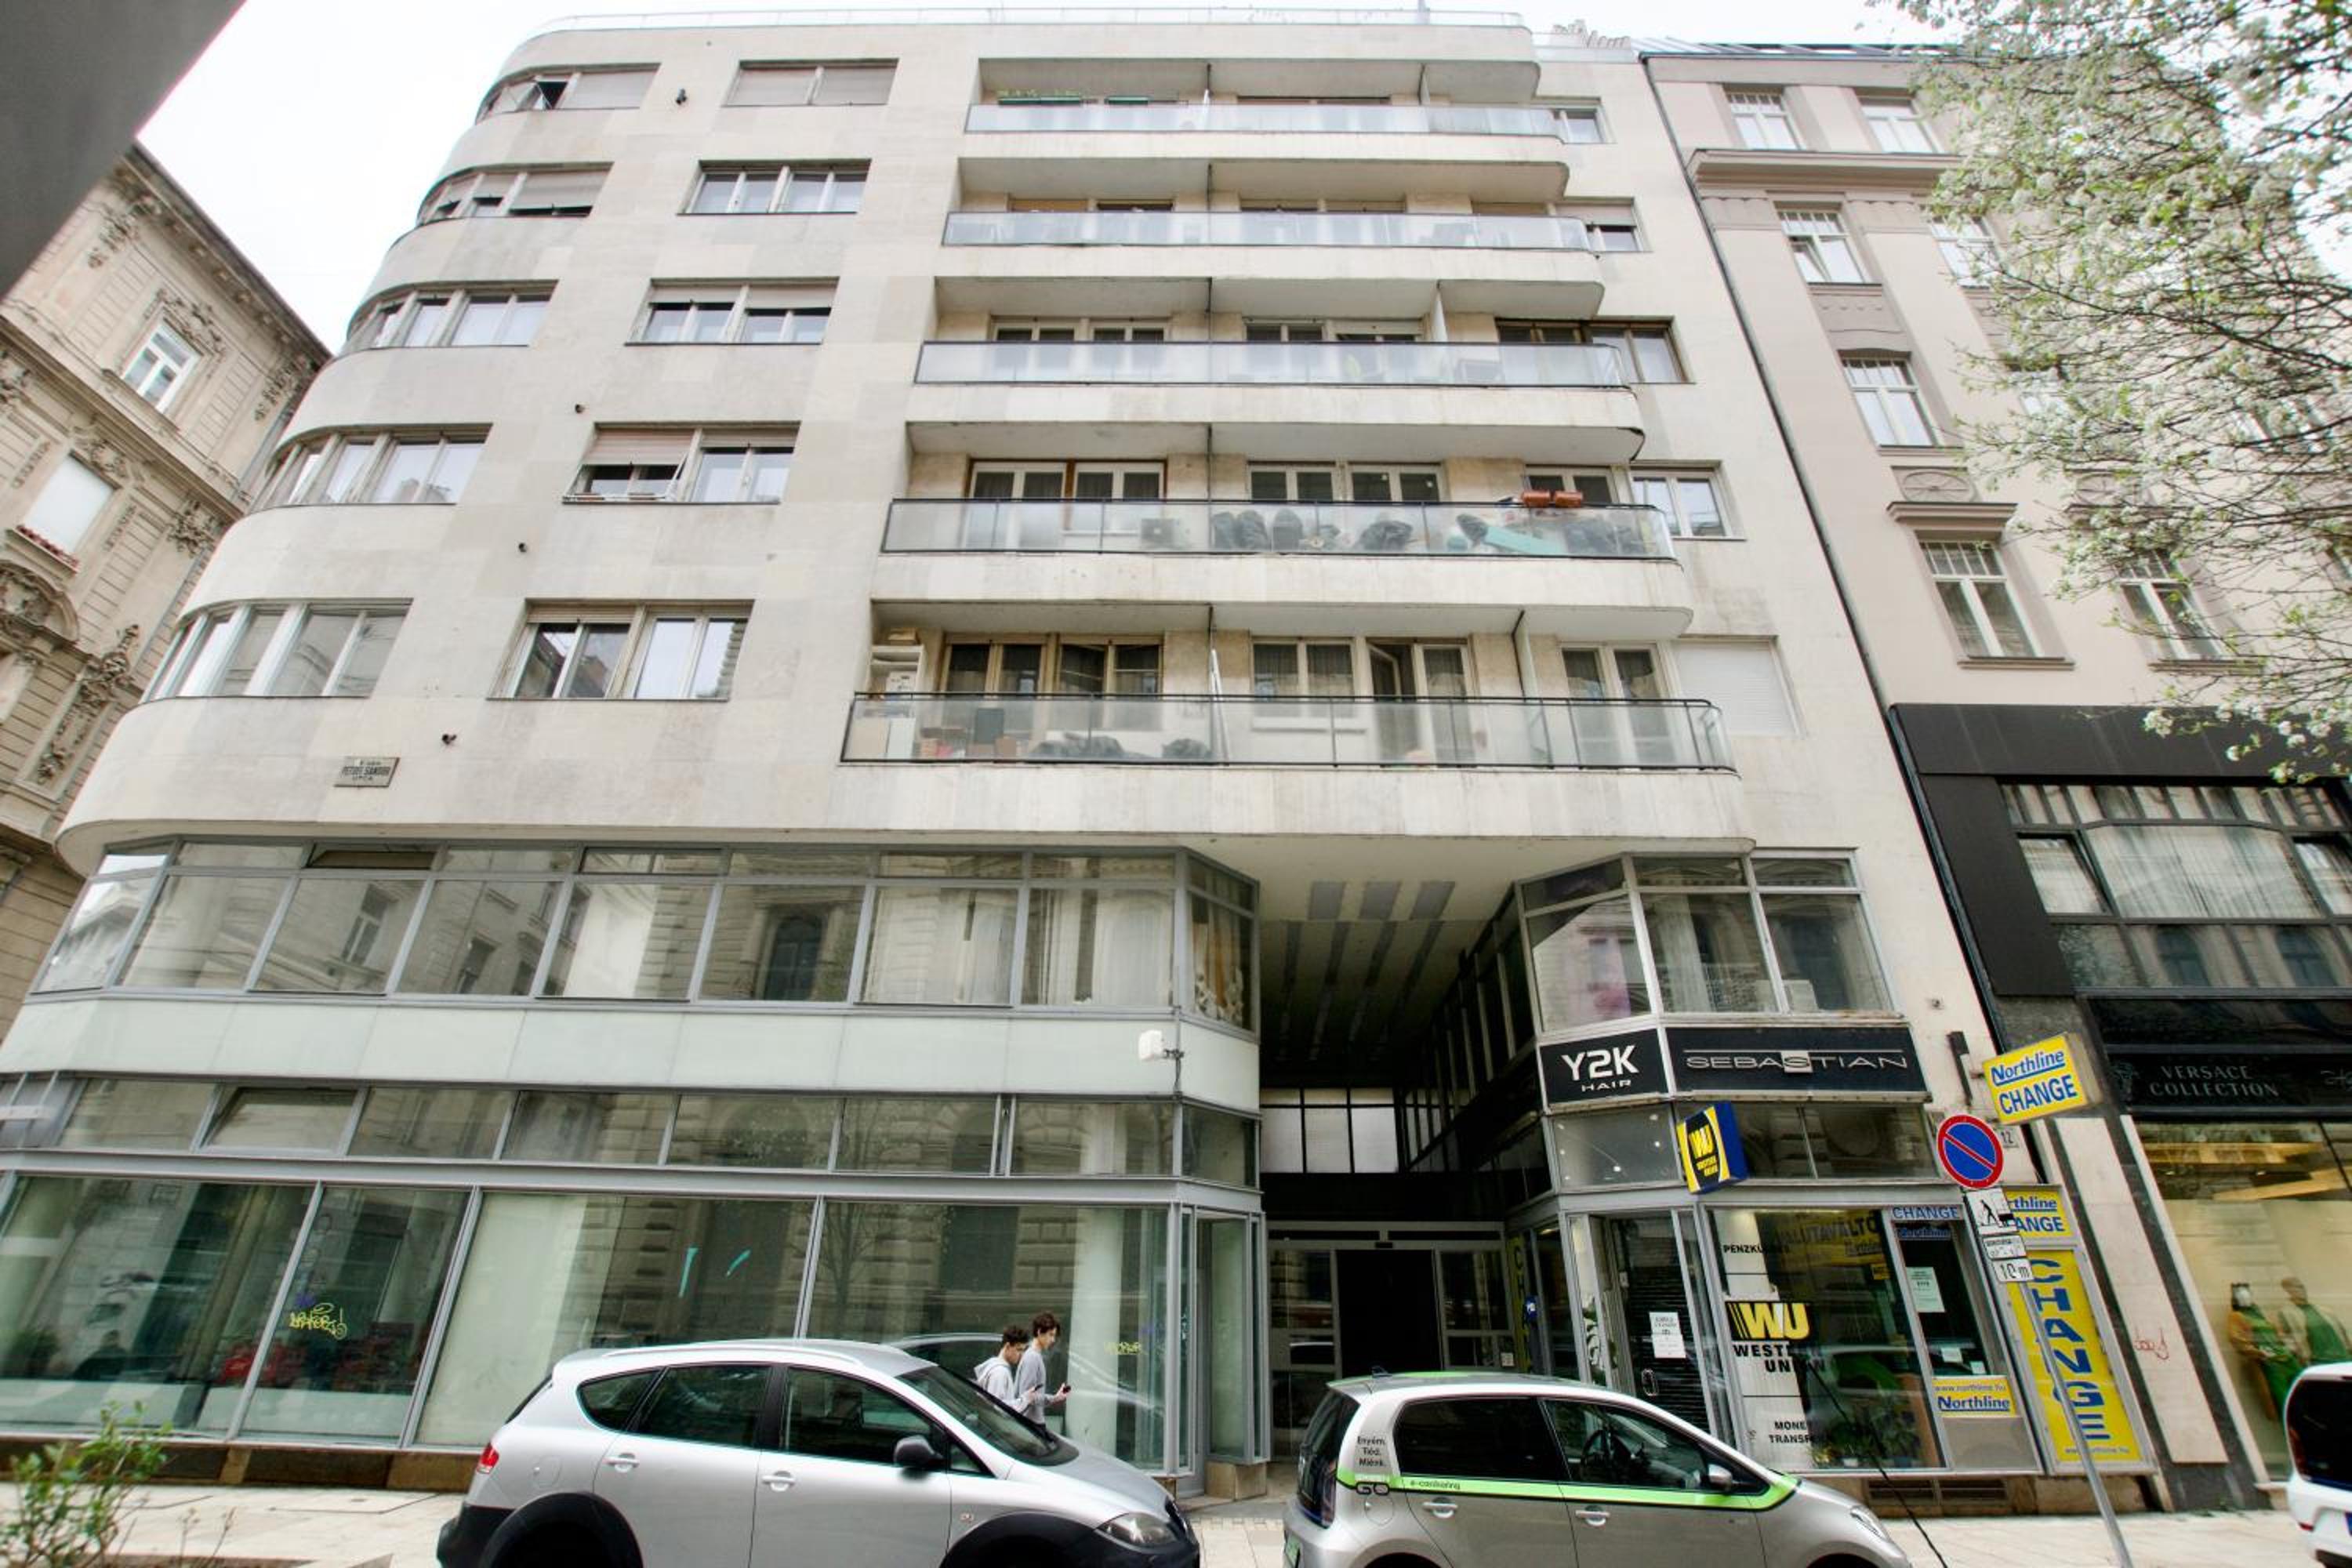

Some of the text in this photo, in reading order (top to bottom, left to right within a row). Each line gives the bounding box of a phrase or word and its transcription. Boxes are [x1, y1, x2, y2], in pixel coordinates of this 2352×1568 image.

[1560, 1044, 1639, 1081] Y2K
[1686, 1054, 1907, 1069] SEBASTIAN
[1991, 1051, 2065, 1085] Northline
[2160, 1065, 2253, 1080] VERSACE
[1581, 1079, 1631, 1092] HAIR
[2149, 1082, 2279, 1097] COLLECTION
[1999, 1074, 2078, 1114] CHANGE
[2009, 1196, 2057, 1209] rthline
[1893, 1207, 1958, 1219] CHANGE
[2009, 1217, 2065, 1232] ANGE
[2000, 1263, 2031, 1279] 10 m
[1727, 1302, 1809, 1339] WU
[2028, 1259, 2111, 1439] CHANGE
[1937, 1396, 2010, 1411] Northline
